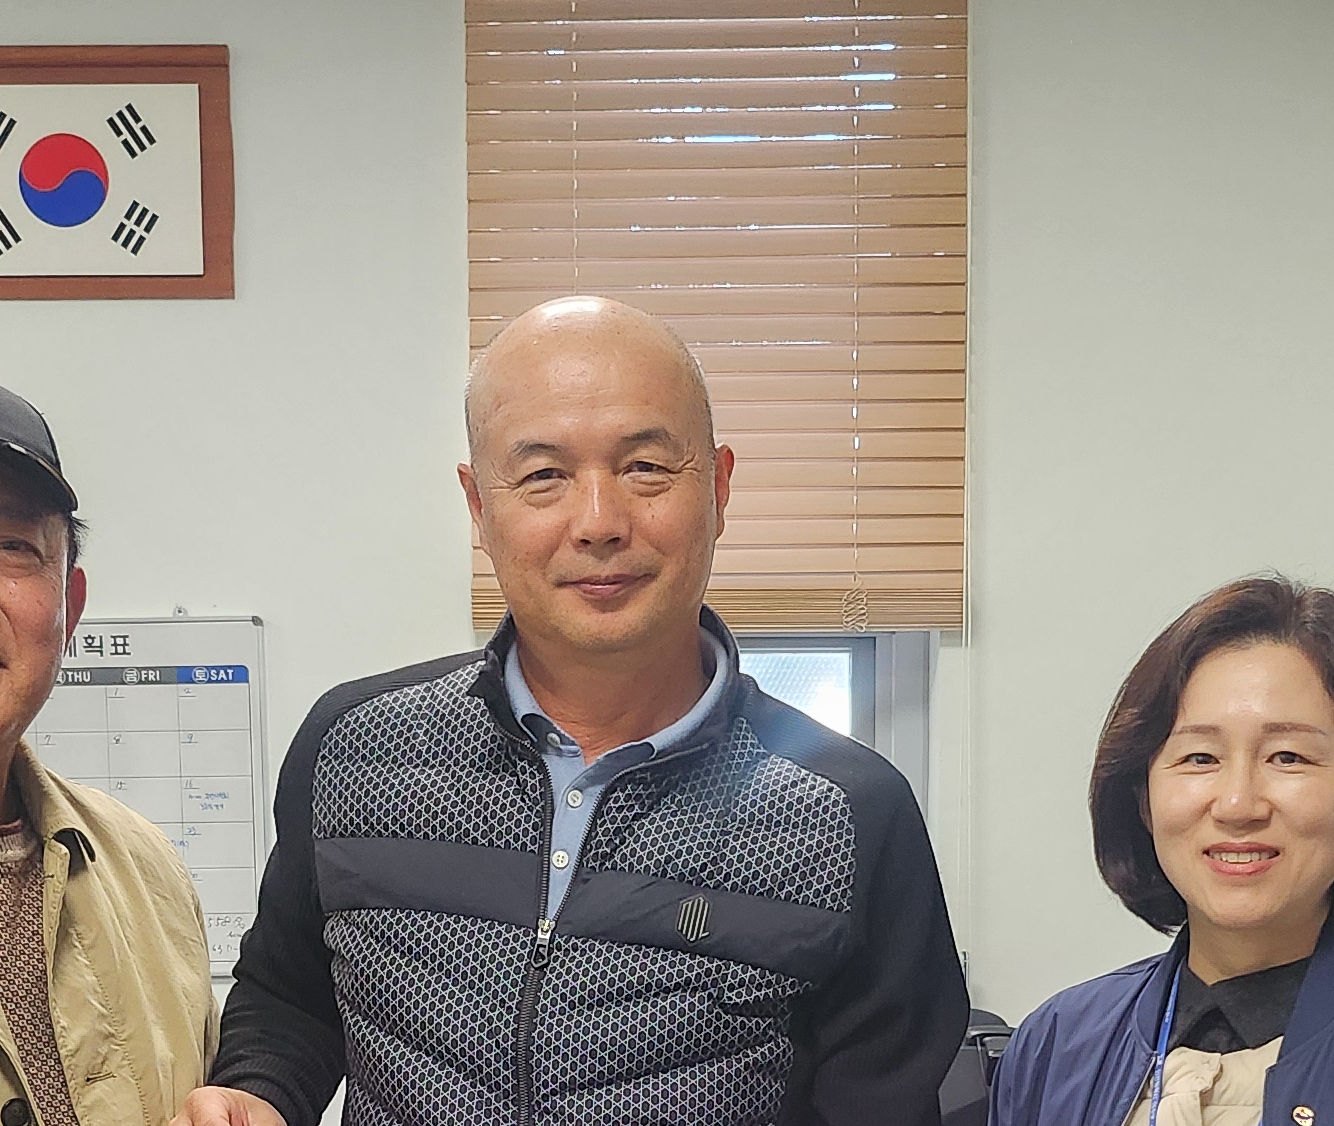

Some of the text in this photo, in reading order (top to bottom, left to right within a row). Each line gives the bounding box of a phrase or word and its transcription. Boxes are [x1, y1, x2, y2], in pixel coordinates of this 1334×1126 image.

[67, 672, 91, 683] THU
[141, 670, 161, 681] FRI
[210, 669, 234, 681] SAT
